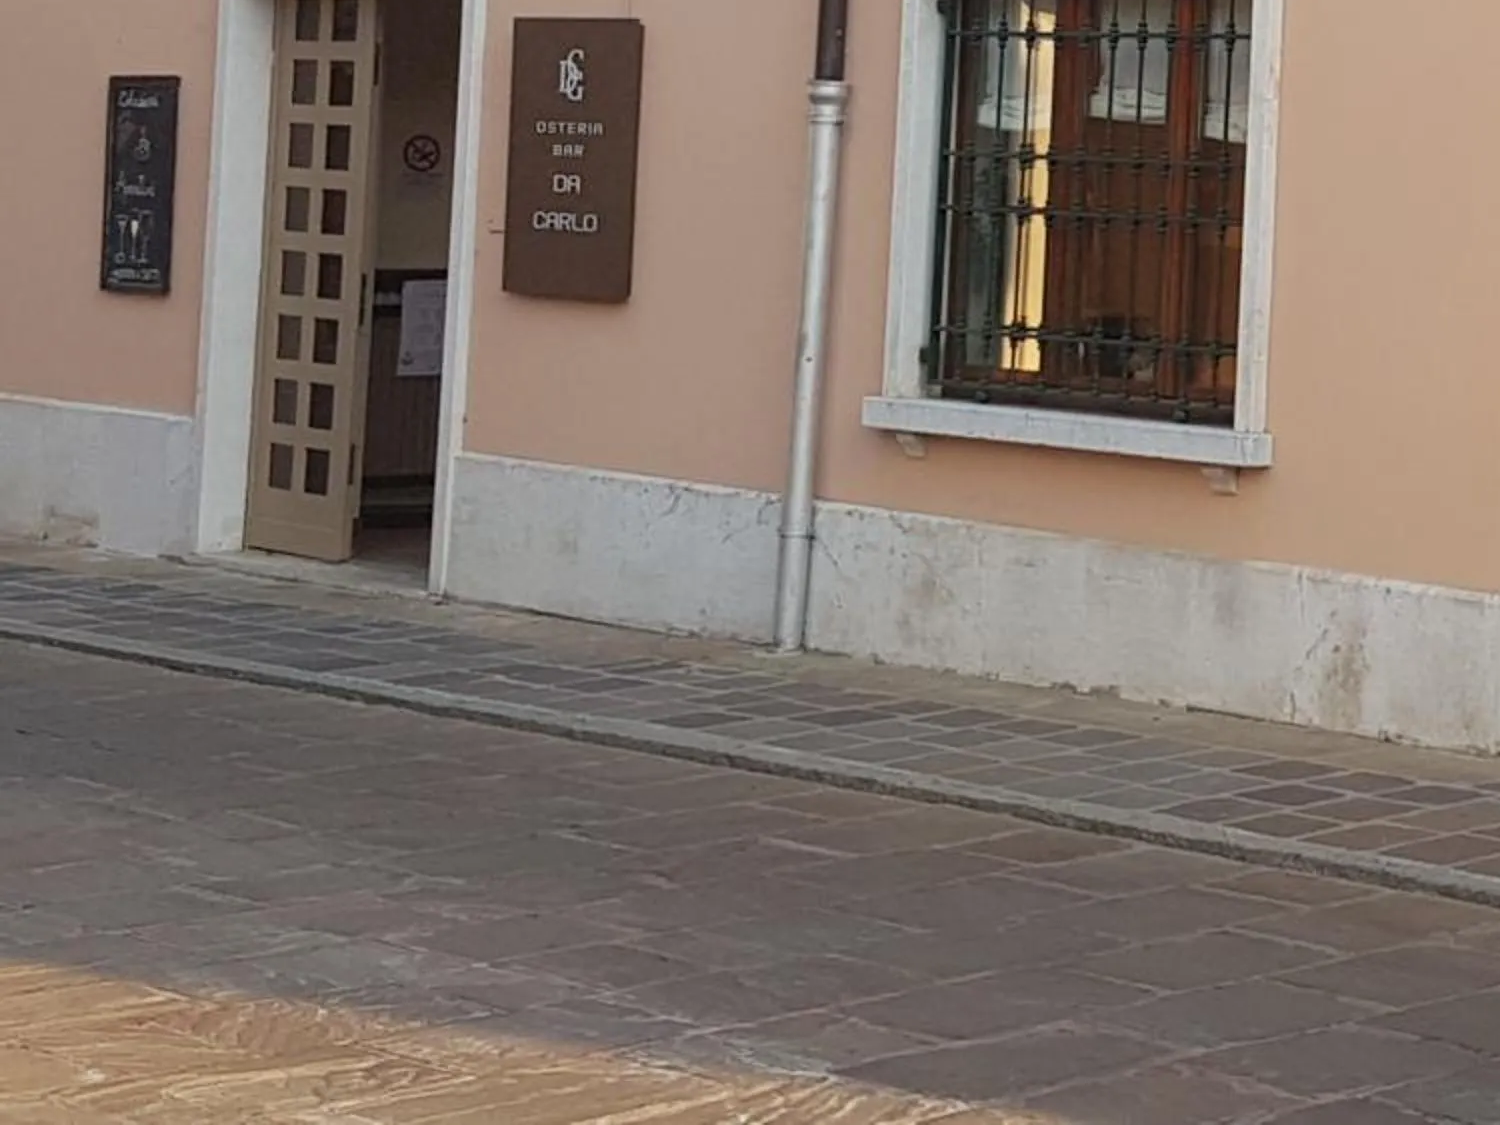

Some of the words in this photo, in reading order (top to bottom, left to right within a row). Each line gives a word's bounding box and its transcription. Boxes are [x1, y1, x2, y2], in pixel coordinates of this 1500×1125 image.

[535, 121, 603, 135] OSTERIA
[552, 144, 585, 157] BAR
[552, 174, 581, 195] DA
[532, 210, 598, 233] CARLO
